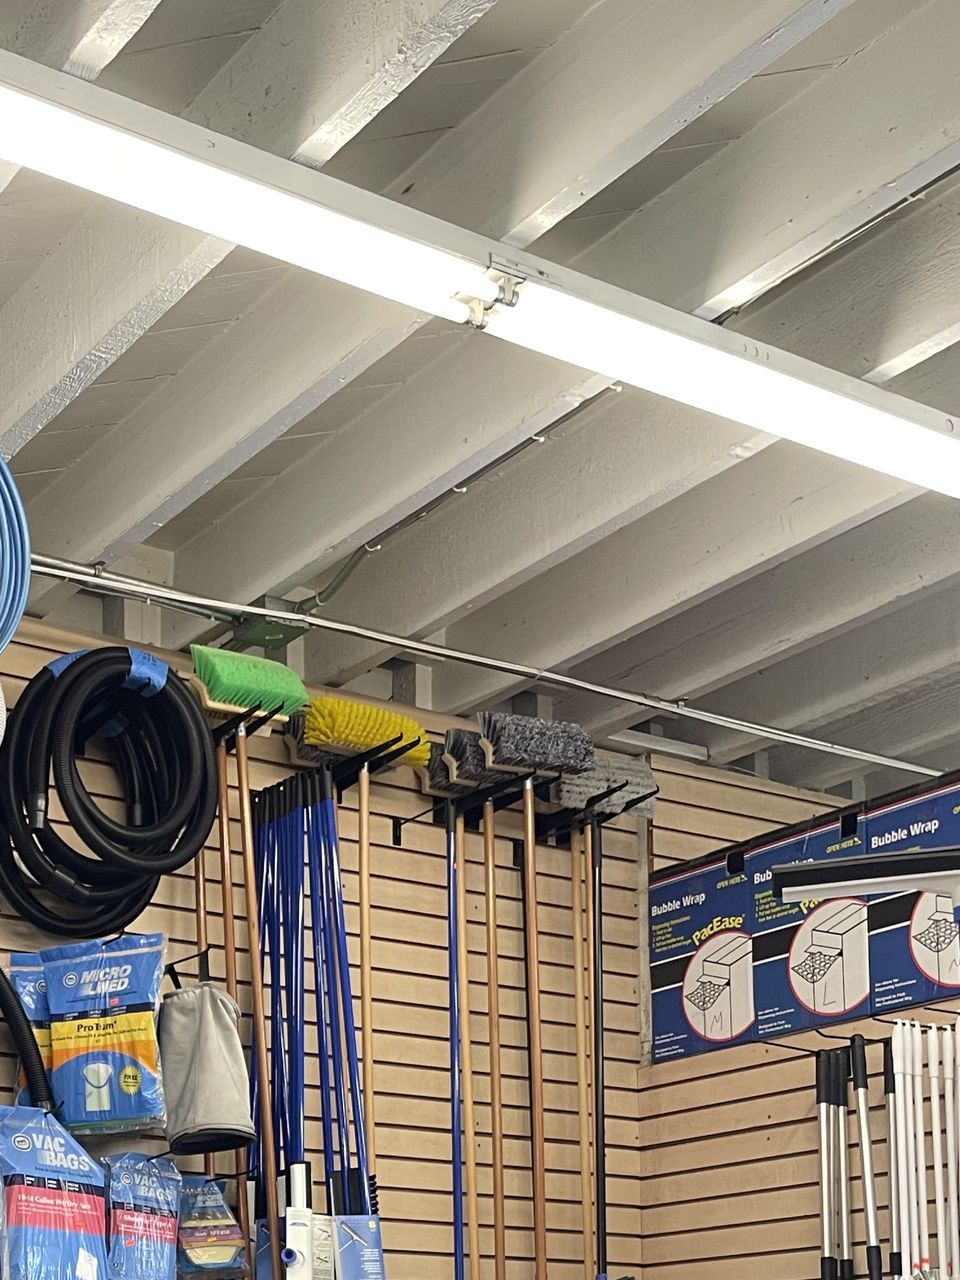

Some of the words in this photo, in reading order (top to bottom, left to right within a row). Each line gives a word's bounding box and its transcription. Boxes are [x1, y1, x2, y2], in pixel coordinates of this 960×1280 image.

[871, 827, 908, 849] Bubble
[909, 819, 939, 836] Wrap
[651, 901, 680, 917] Bubble
[682, 893, 706, 908] Wrap
[692, 916, 744, 946] PacEase
[80, 964, 132, 985] MICRO
[32, 1133, 66, 1153] VAC
[46, 1151, 91, 1172] BAGS
